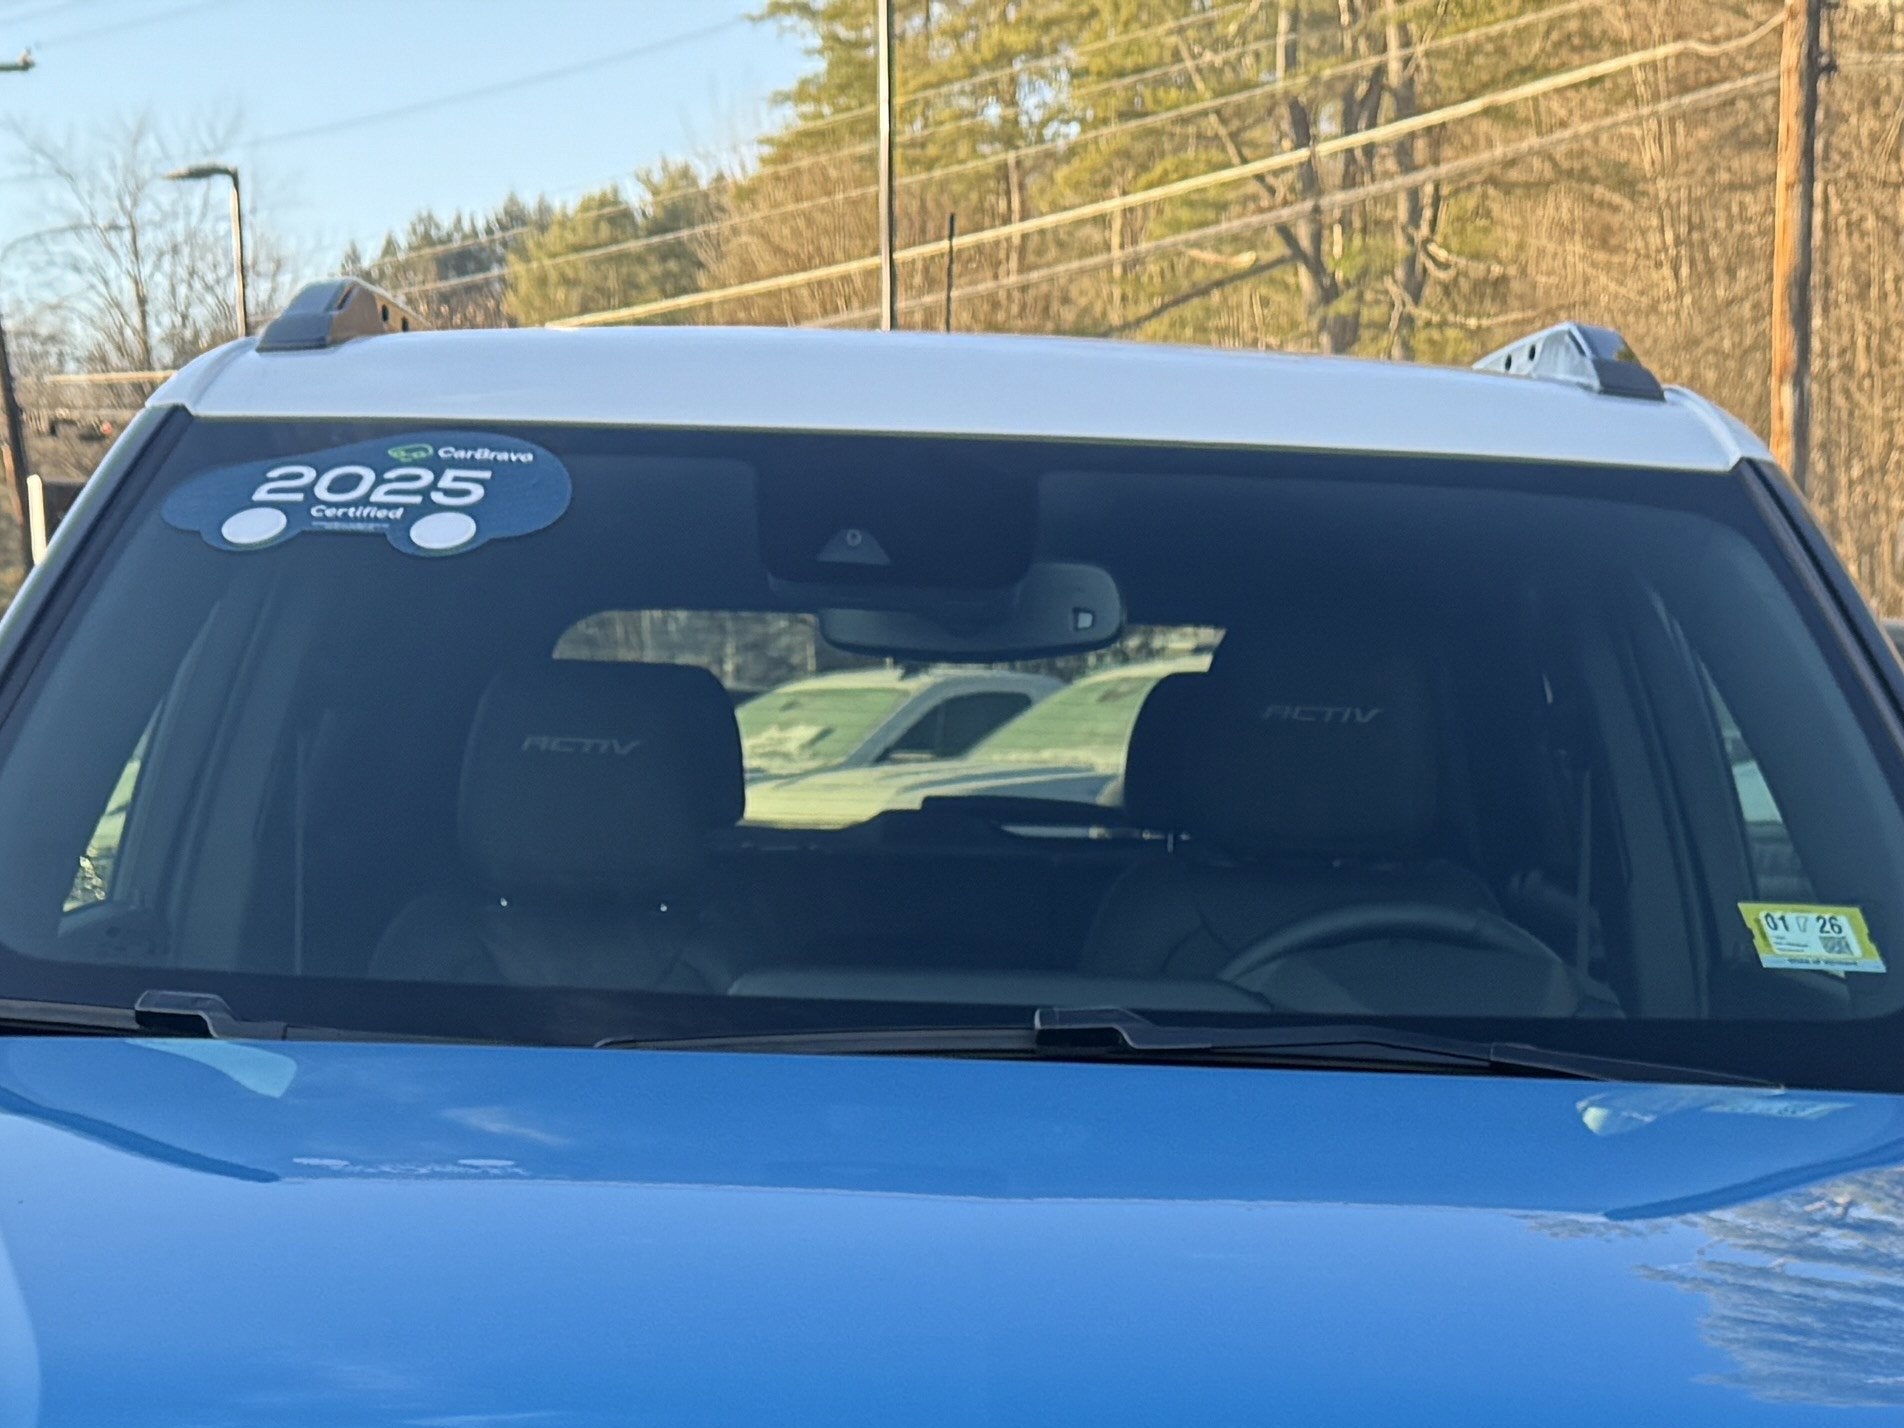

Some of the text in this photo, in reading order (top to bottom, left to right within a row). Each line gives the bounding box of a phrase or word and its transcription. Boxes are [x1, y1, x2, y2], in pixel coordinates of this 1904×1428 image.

[251, 464, 493, 506] 2025
[310, 504, 404, 520] Certified
[1764, 912, 1843, 934] 01 26
